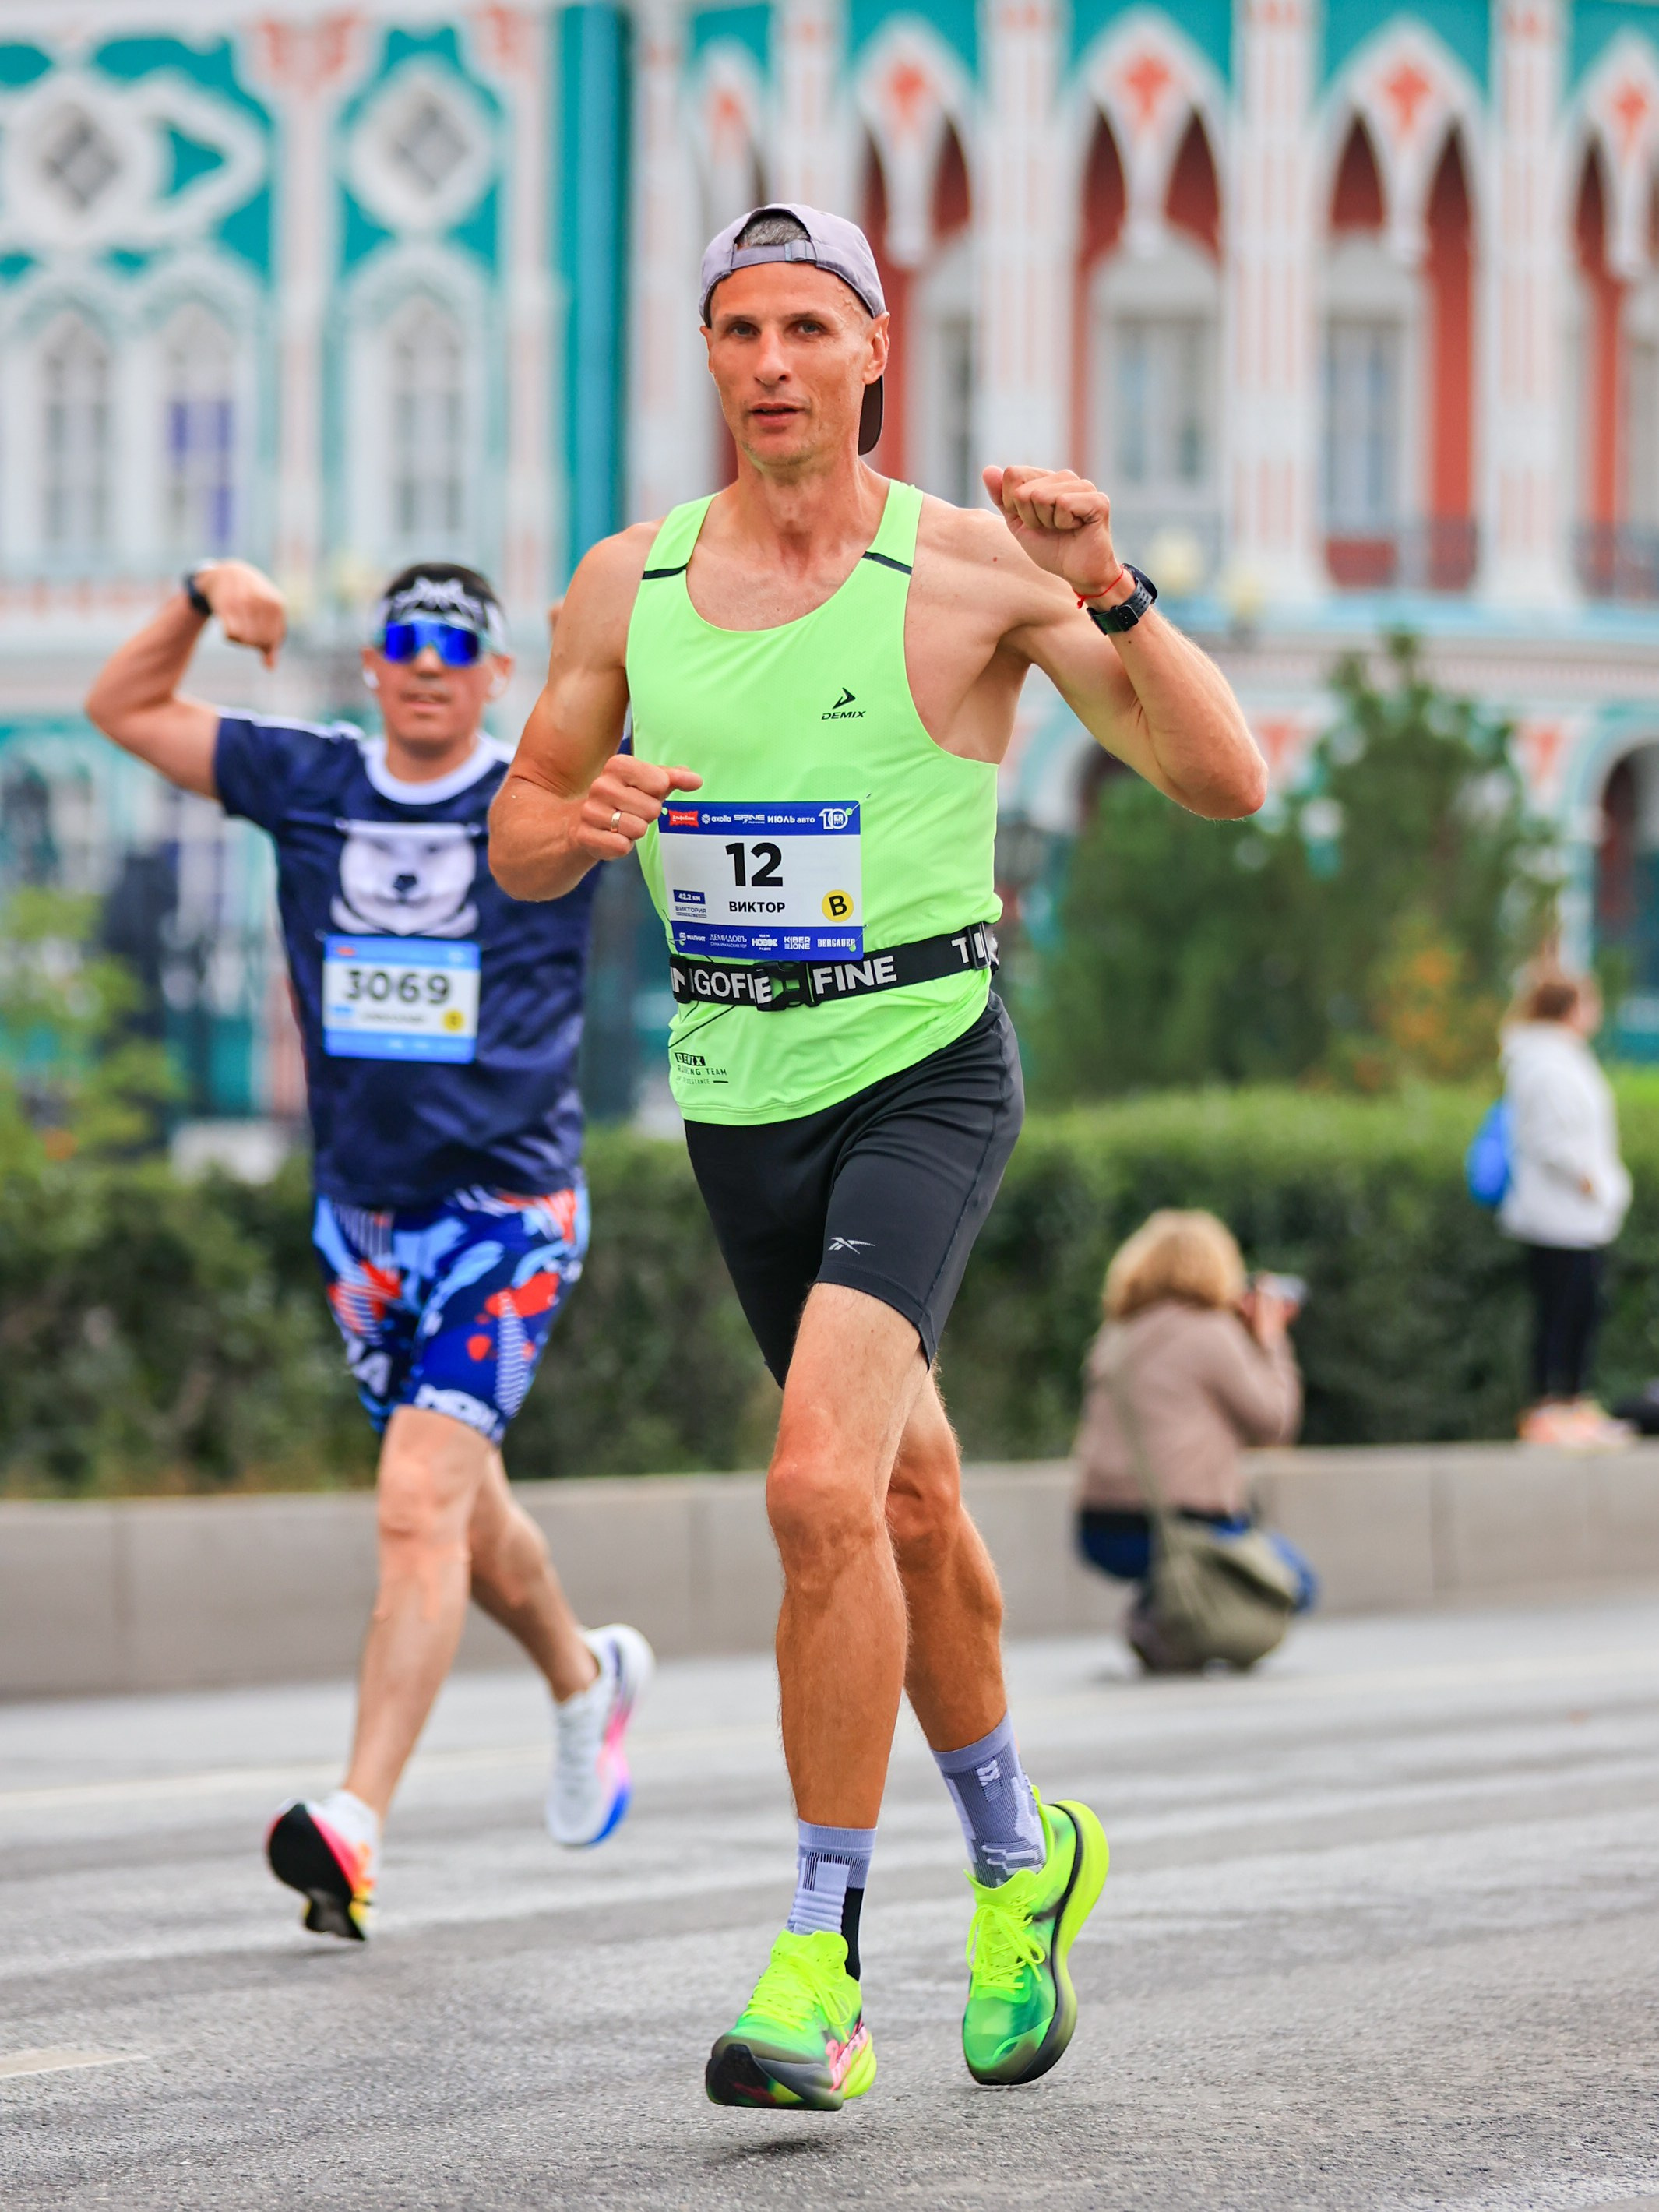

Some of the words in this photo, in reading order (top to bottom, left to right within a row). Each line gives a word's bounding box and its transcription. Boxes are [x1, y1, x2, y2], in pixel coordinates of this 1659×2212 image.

[821, 711, 866, 720] DEMIX
[725, 842, 784, 887] 12
[729, 900, 786, 914] ВИКТОР
[829, 895, 847, 916] B
[345, 970, 452, 1006] 3069
[812, 956, 897, 995] FINE
